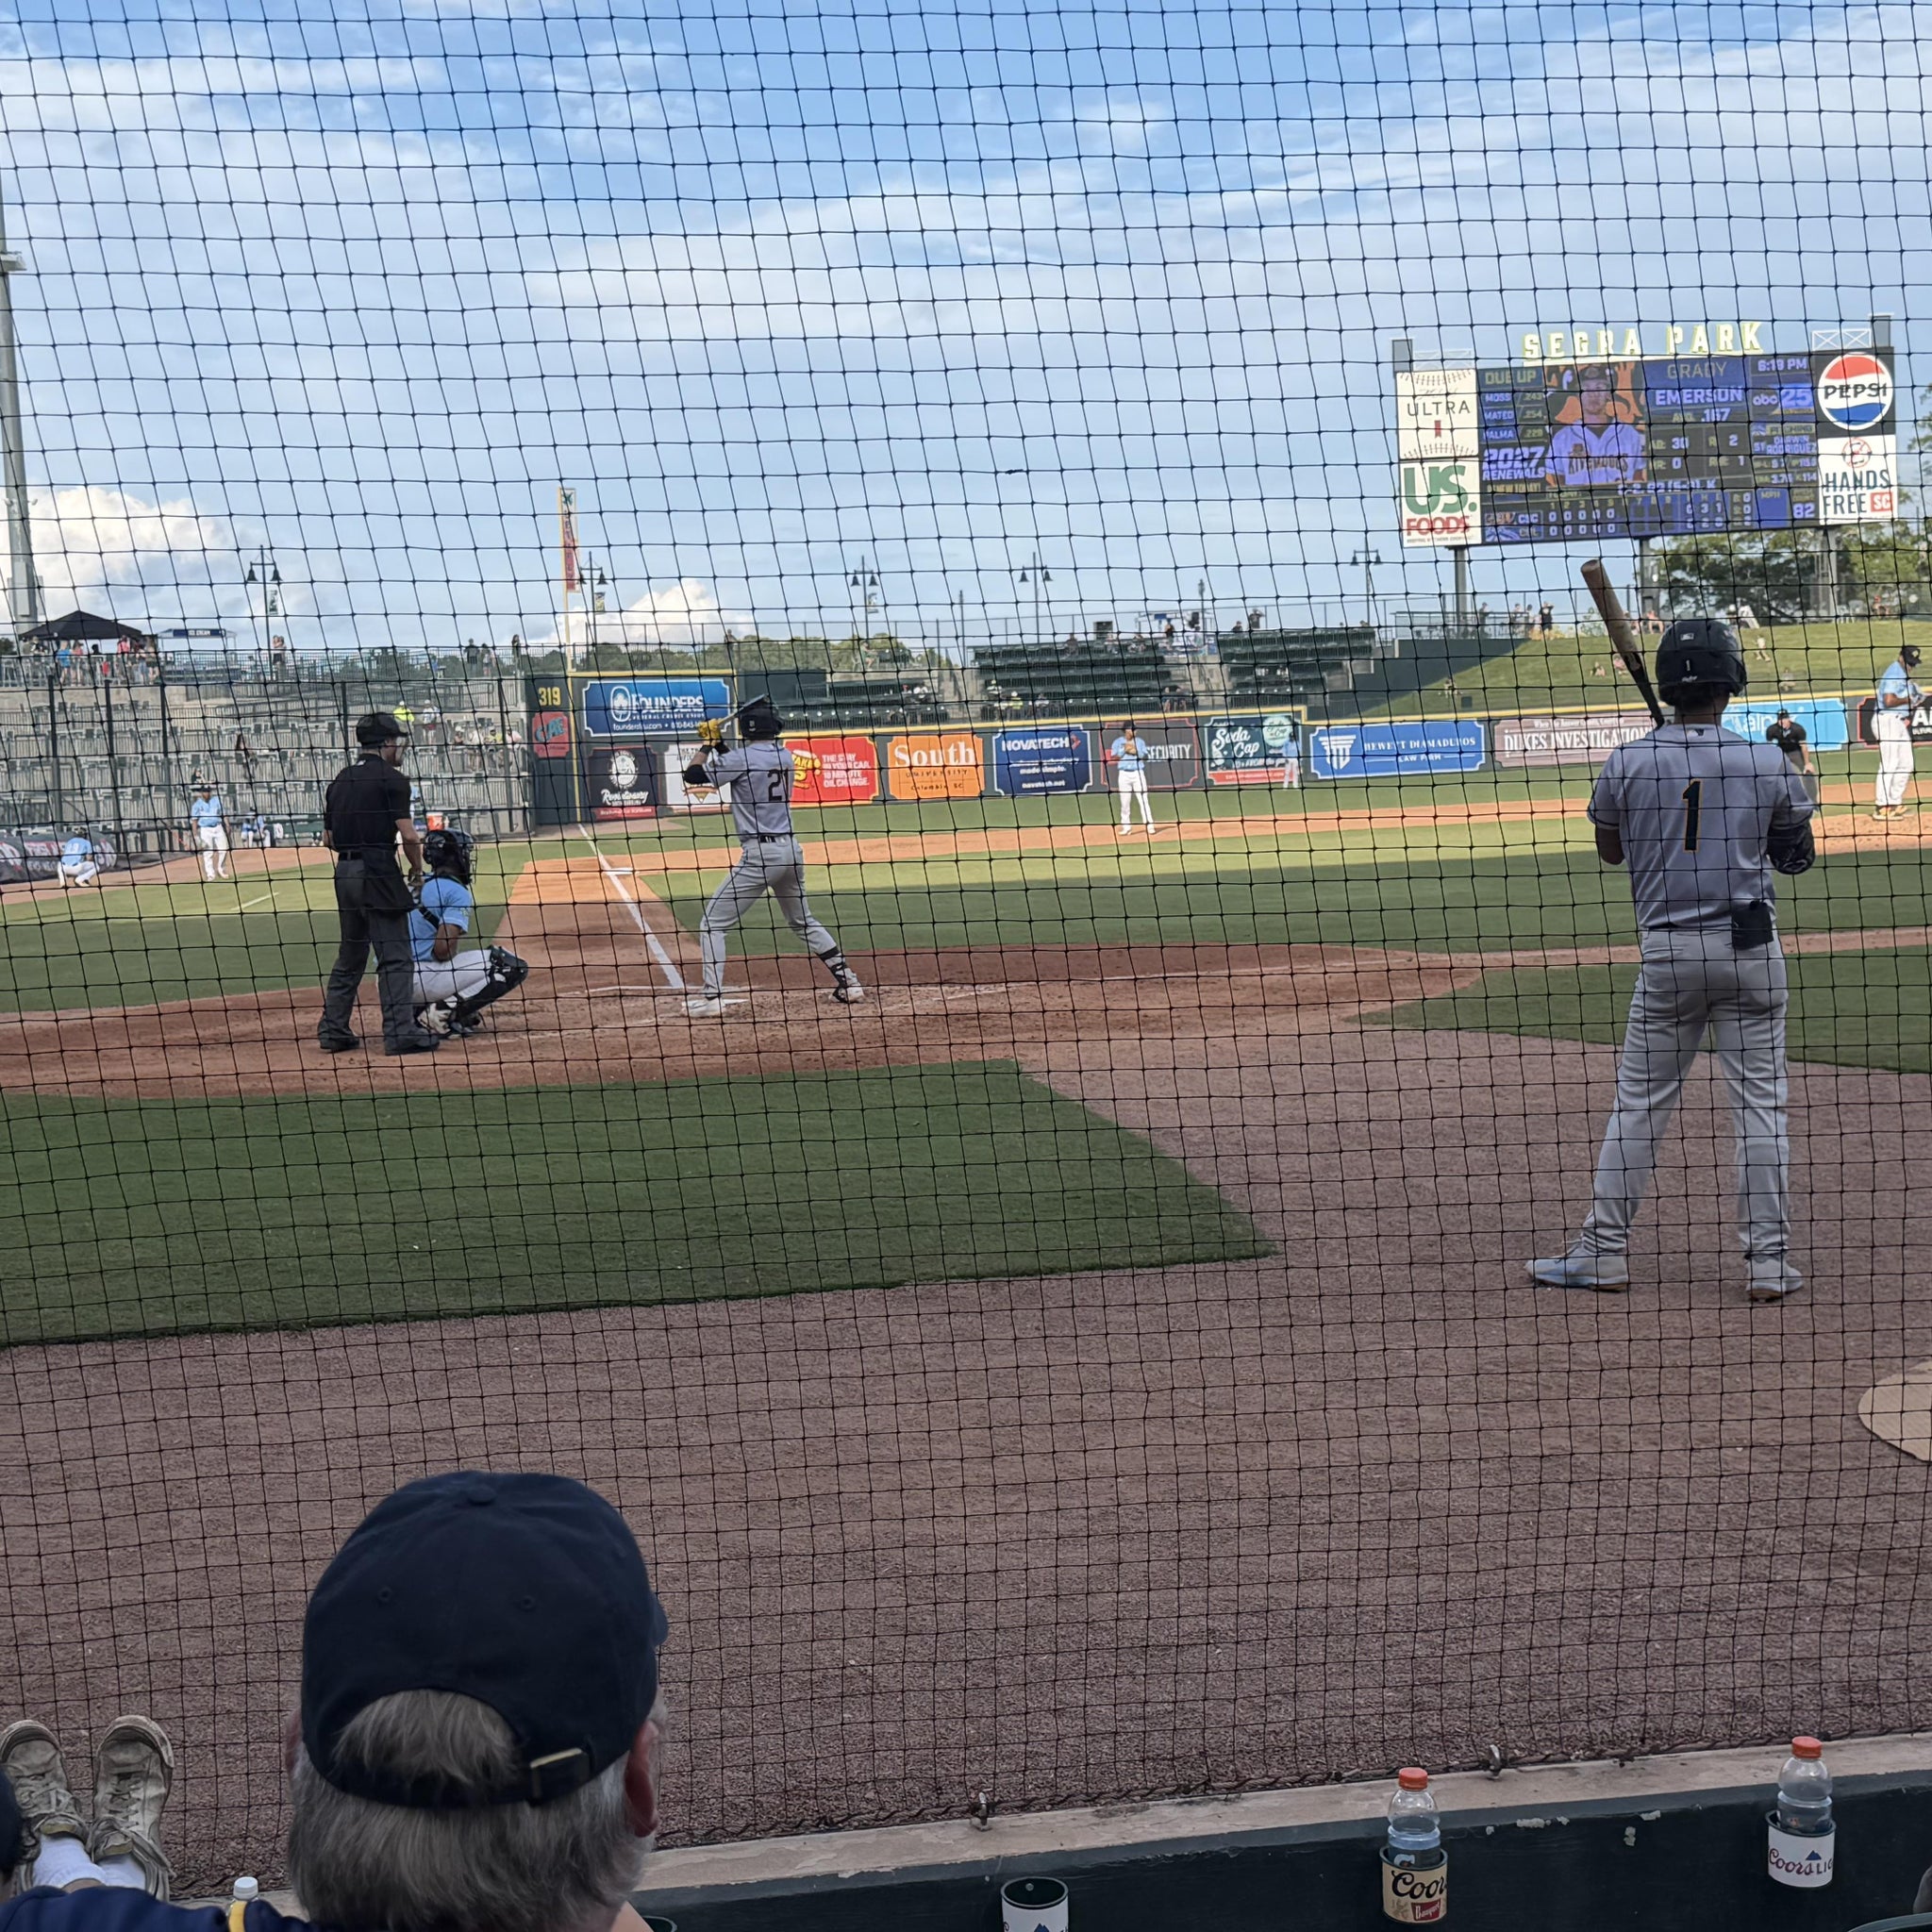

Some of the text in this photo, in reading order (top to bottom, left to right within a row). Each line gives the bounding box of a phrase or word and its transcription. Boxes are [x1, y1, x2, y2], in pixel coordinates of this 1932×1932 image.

[1524, 322, 1762, 358] SEGRA PARK
[1667, 361, 1727, 379] GRADY
[1787, 358, 1807, 370] PM
[1485, 370, 1537, 385] DUE UP
[1656, 387, 1744, 406] EMERSON
[1752, 388, 1812, 406] abc 25
[1824, 382, 1888, 400] PEPSI
[1407, 400, 1471, 417] ULTRA
[1484, 410, 1514, 420] MATEO
[1729, 435, 1738, 446] 2
[1482, 446, 1545, 470] 2027
[1672, 458, 1681, 469] 0
[1739, 456, 1744, 466] 1
[1482, 467, 1546, 481] RENEWALS
[1824, 470, 1890, 492] HANDS
[1404, 464, 1478, 515] US.
[1549, 511, 1557, 522] 0
[1564, 510, 1573, 521] 0
[1578, 509, 1586, 520] 0
[1607, 508, 1615, 519] 0
[1701, 503, 1709, 513] 3
[1716, 502, 1722, 512] 1
[1793, 503, 1815, 518] 82
[1823, 493, 1891, 516] FREE SC
[1407, 516, 1471, 537] FOODS
[1550, 525, 1557, 536] 0
[1564, 525, 1573, 536] 0
[1578, 525, 1587, 535] 0
[1607, 524, 1615, 533] 0
[538, 687, 561, 707] 319
[632, 693, 704, 714] FOUNDERS
[1002, 738, 1070, 752] NOVATECH
[1211, 725, 1252, 751] Soda
[1364, 740, 1406, 752] HEWETT
[1505, 732, 1548, 753] DUKES
[893, 741, 976, 767] South
[1234, 741, 1260, 758] Cap
[1398, 754, 1441, 763] LAW FIRM
[906, 769, 968, 778] UNIVERSITY
[767, 769, 789, 802] 21
[1682, 778, 1702, 853] 1
[1769, 1848, 1814, 1875] Coors
[1415, 1902, 1441, 1921] Banquet
